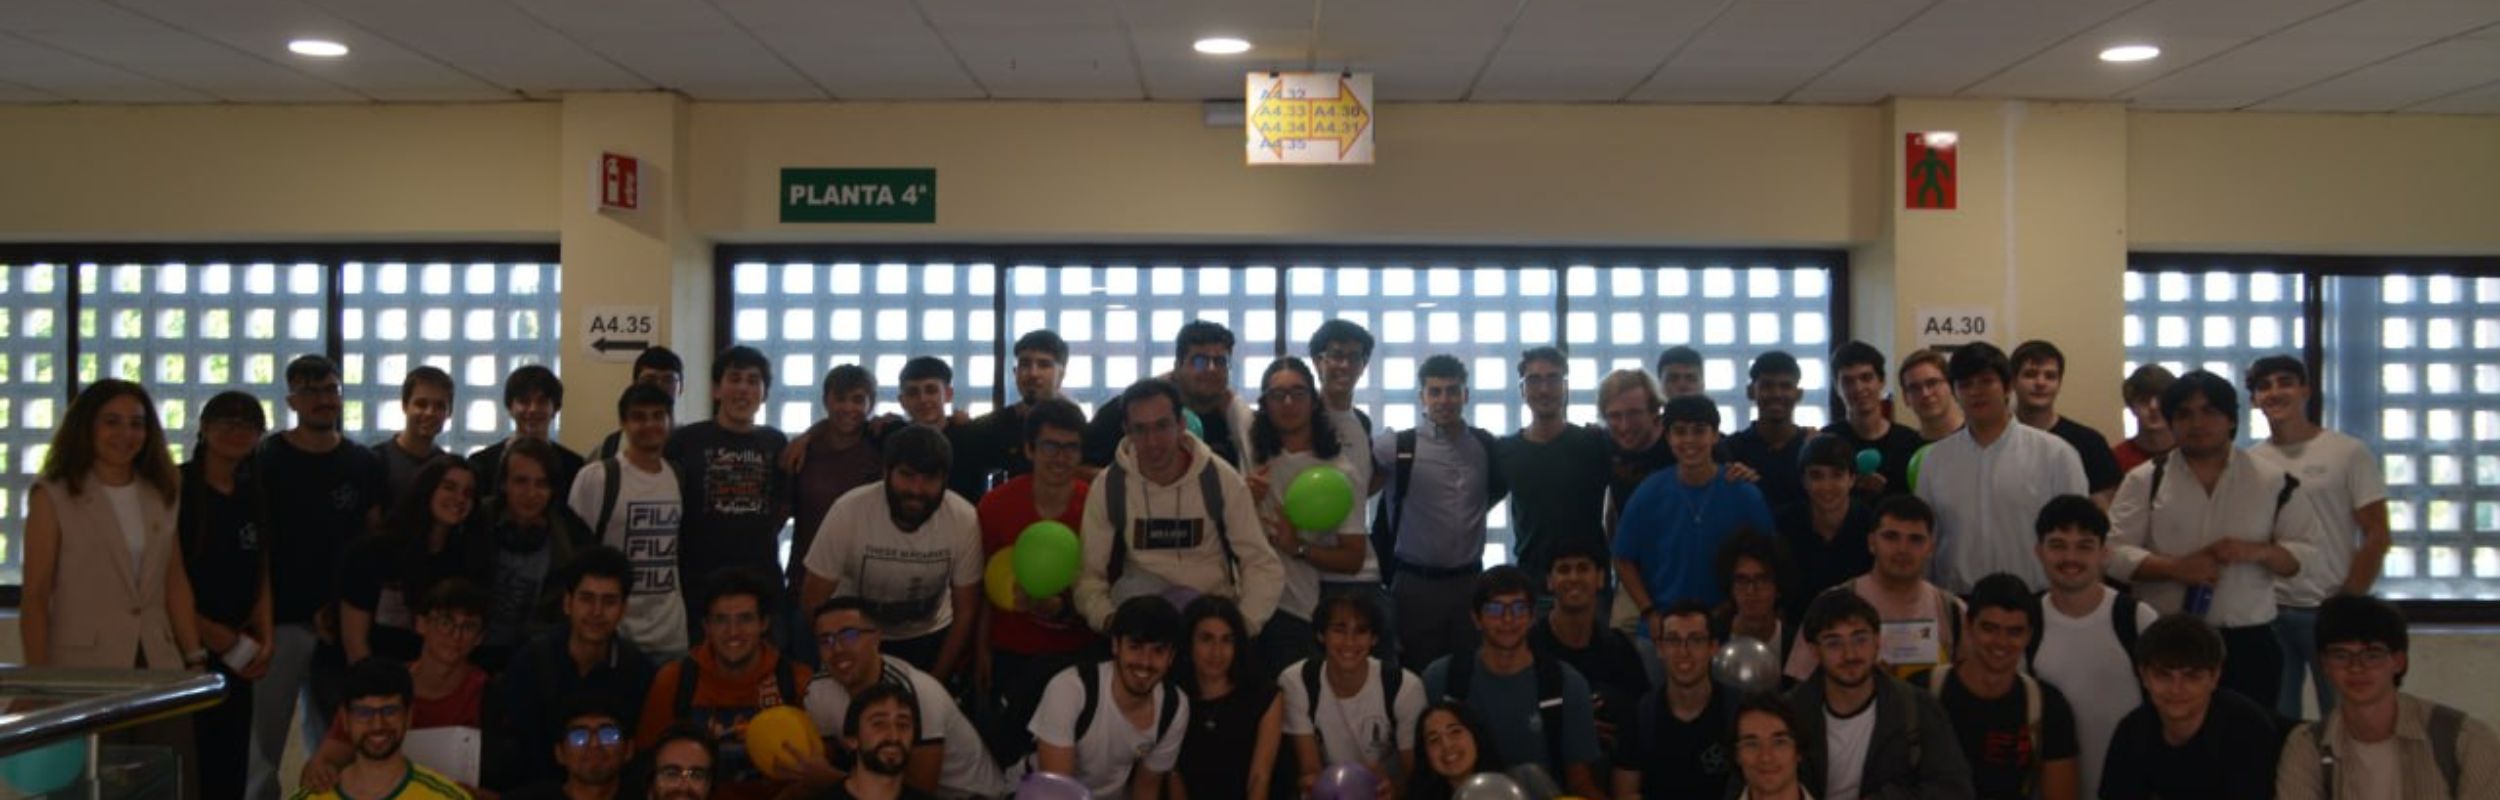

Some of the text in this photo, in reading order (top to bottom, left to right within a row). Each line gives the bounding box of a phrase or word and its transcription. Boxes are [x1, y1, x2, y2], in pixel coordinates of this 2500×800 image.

[789, 183, 895, 206] PLANTA
[590, 315, 651, 333] A4.35
[1924, 316, 1985, 335] A4.30
[633, 507, 680, 526] FILA
